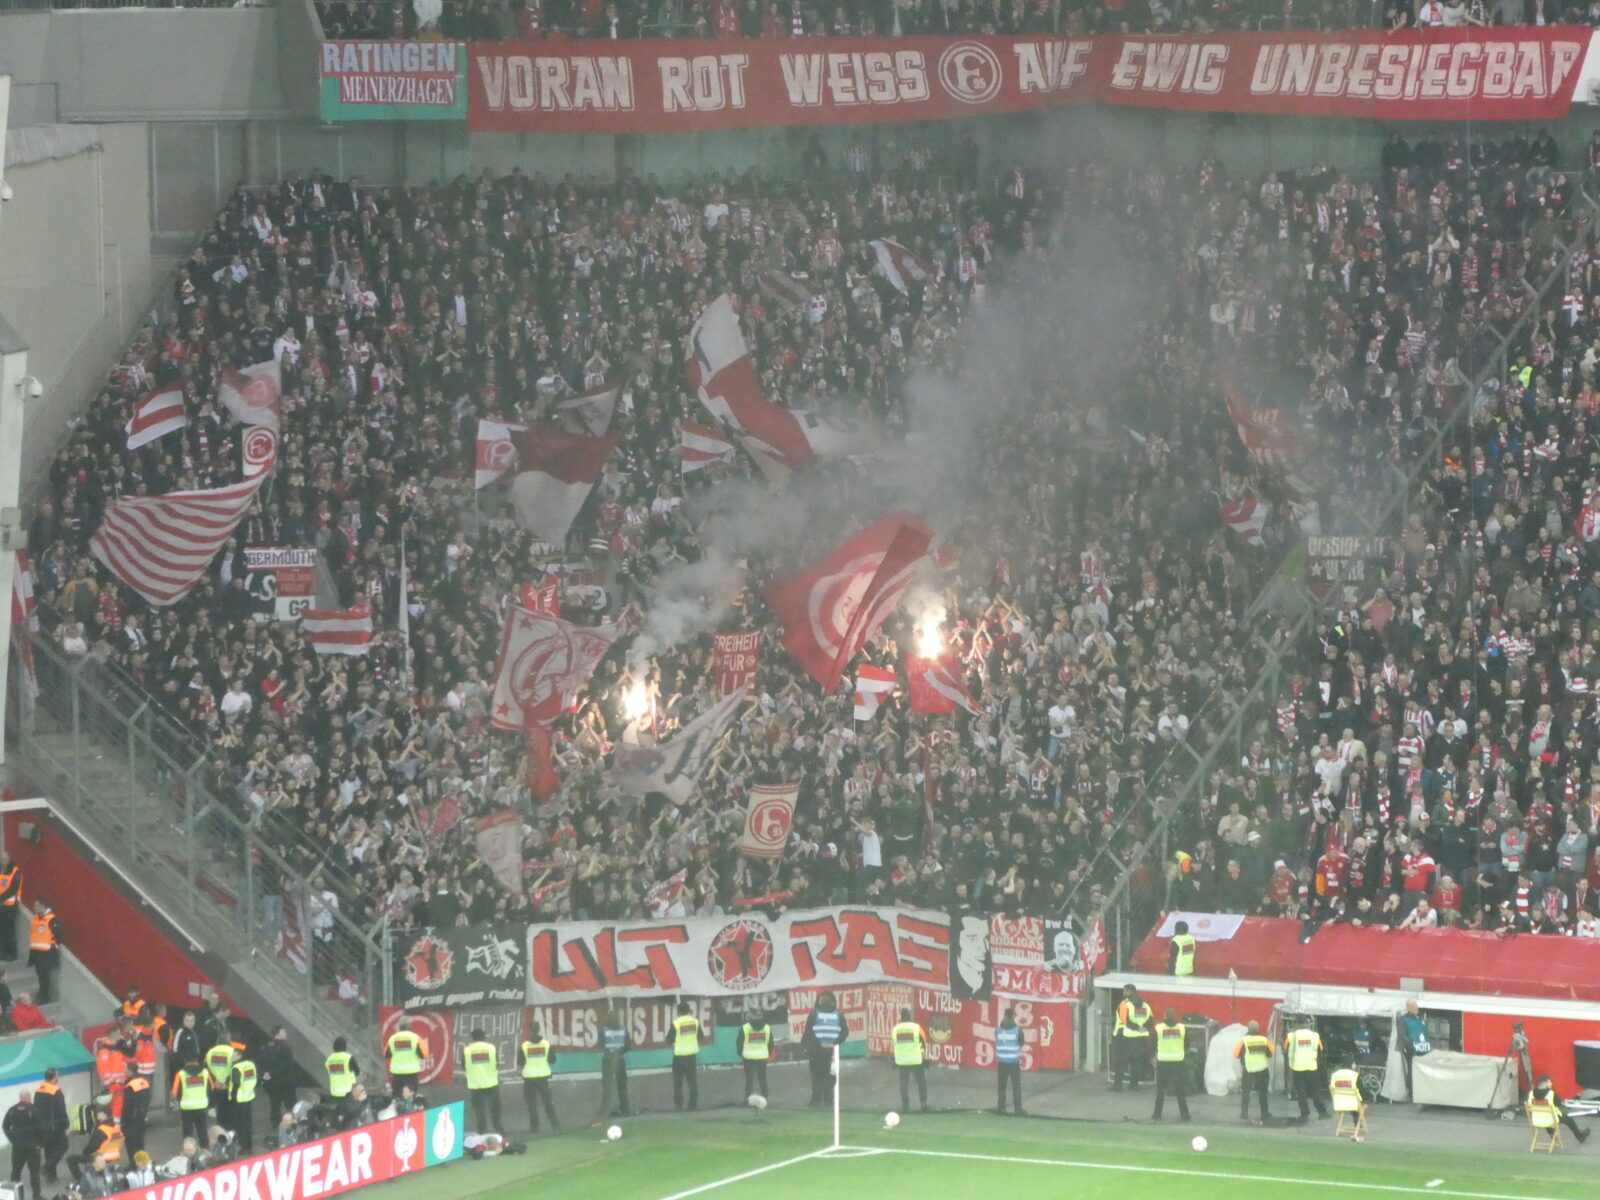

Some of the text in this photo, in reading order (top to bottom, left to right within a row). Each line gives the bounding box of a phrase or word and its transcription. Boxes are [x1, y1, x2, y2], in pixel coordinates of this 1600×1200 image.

[323, 43, 455, 72] RATINGEN
[342, 76, 455, 104] MEINERZHAGEN
[477, 56, 635, 111] VORAN
[658, 54, 748, 112] ROT
[780, 50, 929, 107] WEISS
[1111, 42, 1230, 93] EWIG
[1250, 41, 1581, 99] UNBESIEGBAR
[534, 1006, 599, 1047] ALLES
